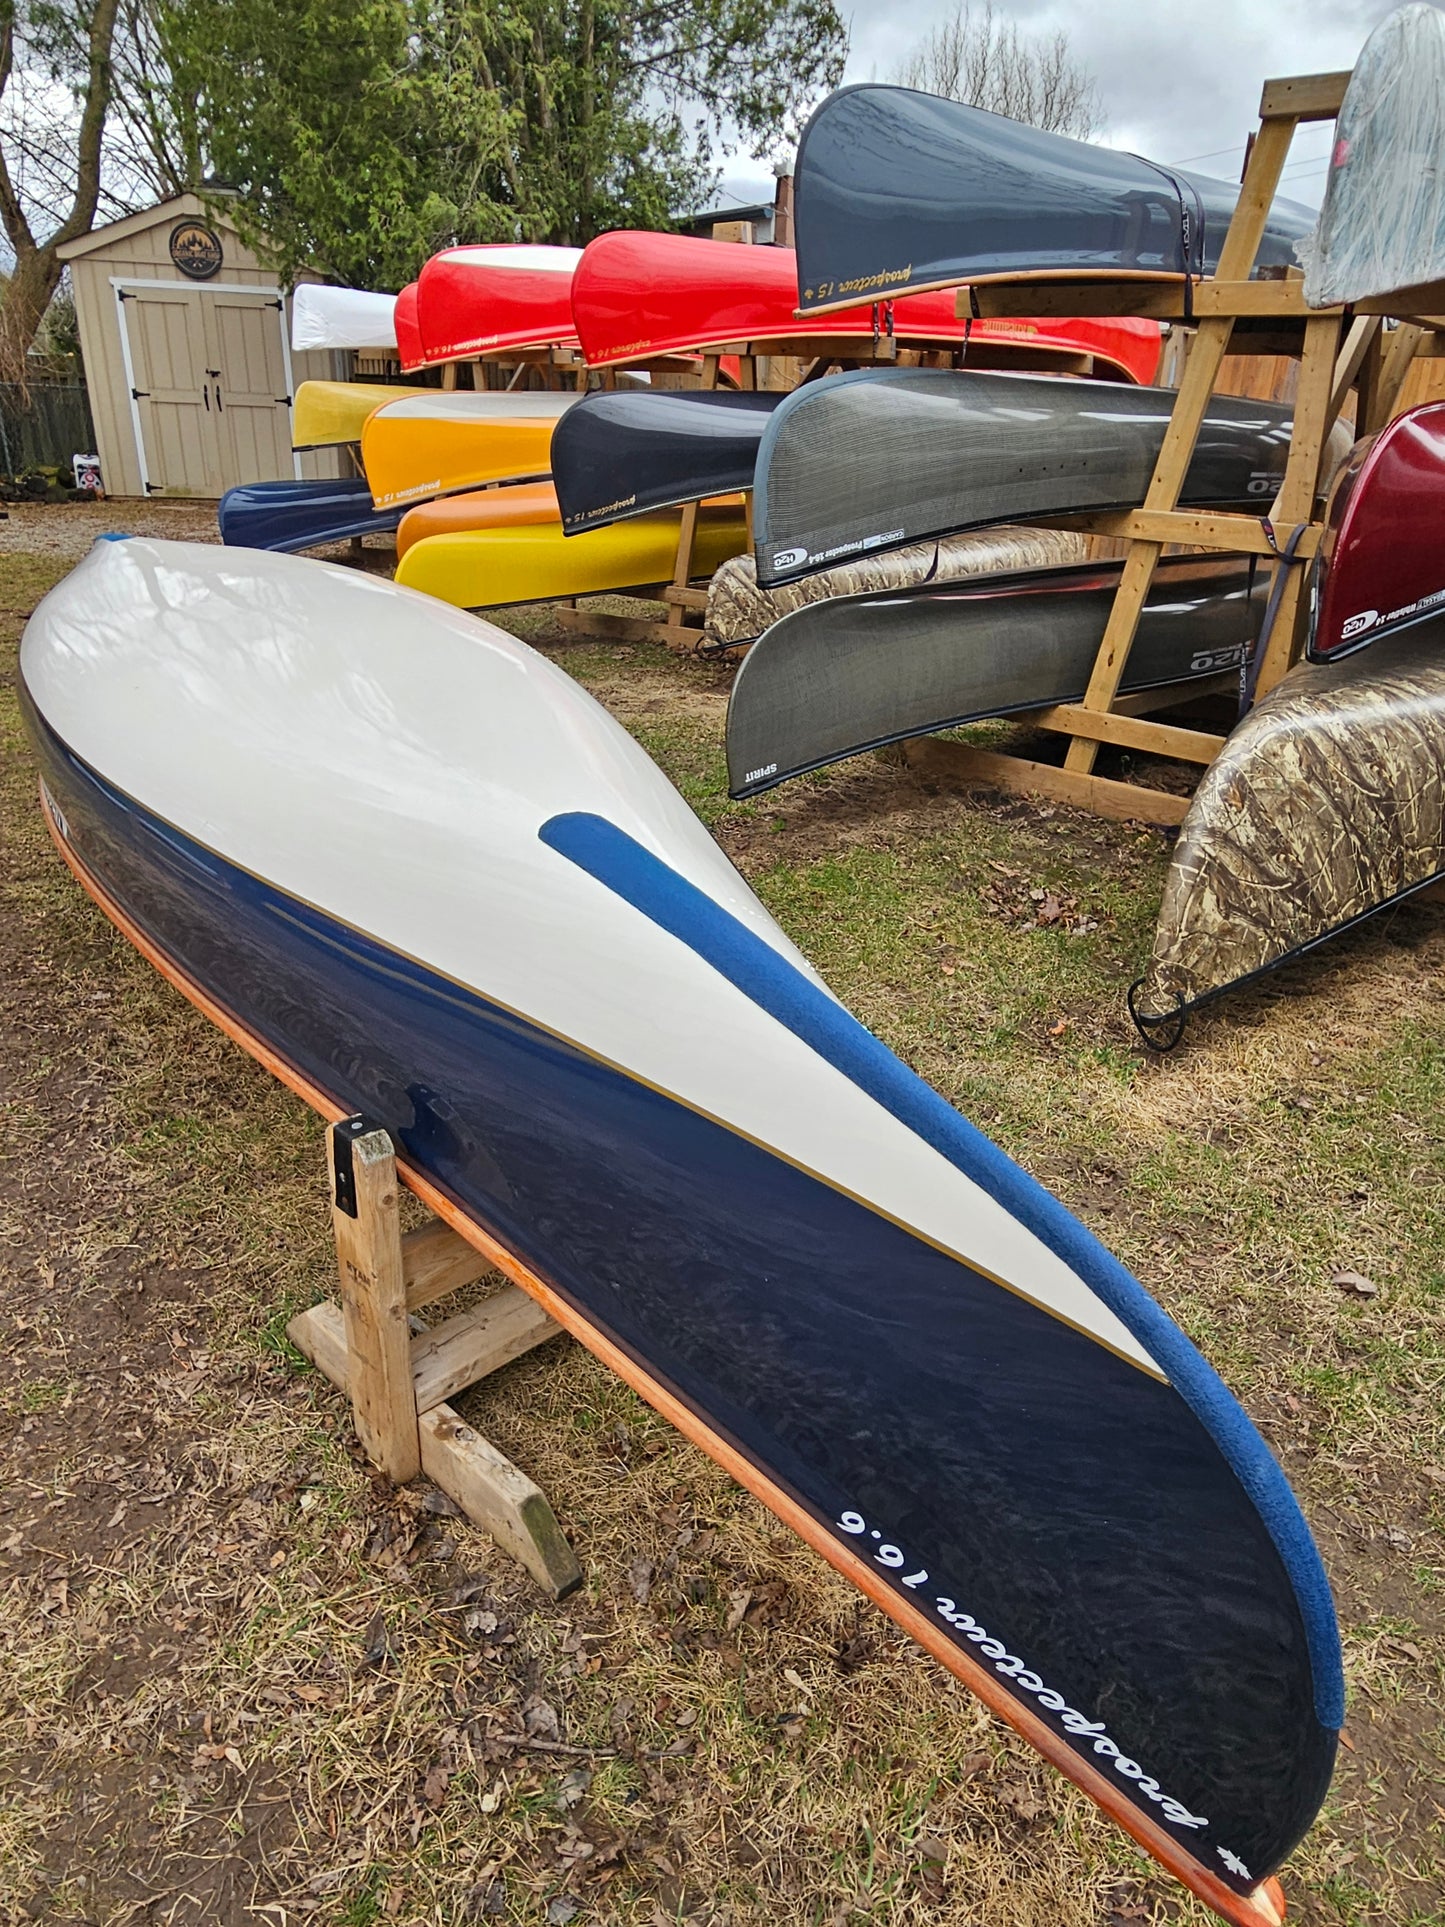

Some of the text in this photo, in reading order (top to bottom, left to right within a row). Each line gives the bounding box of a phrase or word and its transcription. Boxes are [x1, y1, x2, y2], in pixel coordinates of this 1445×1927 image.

[818, 263, 912, 299] prospecteur 15
[597, 348, 609, 359] 16
[1247, 479, 1284, 493] 2O
[384, 492, 394, 502] 15
[574, 493, 636, 523] prospecteur 15
[825, 540, 863, 558] Prospector
[744, 763, 778, 783] SPIRIT
[835, 1509, 1209, 1830] prospecteur 16.6
